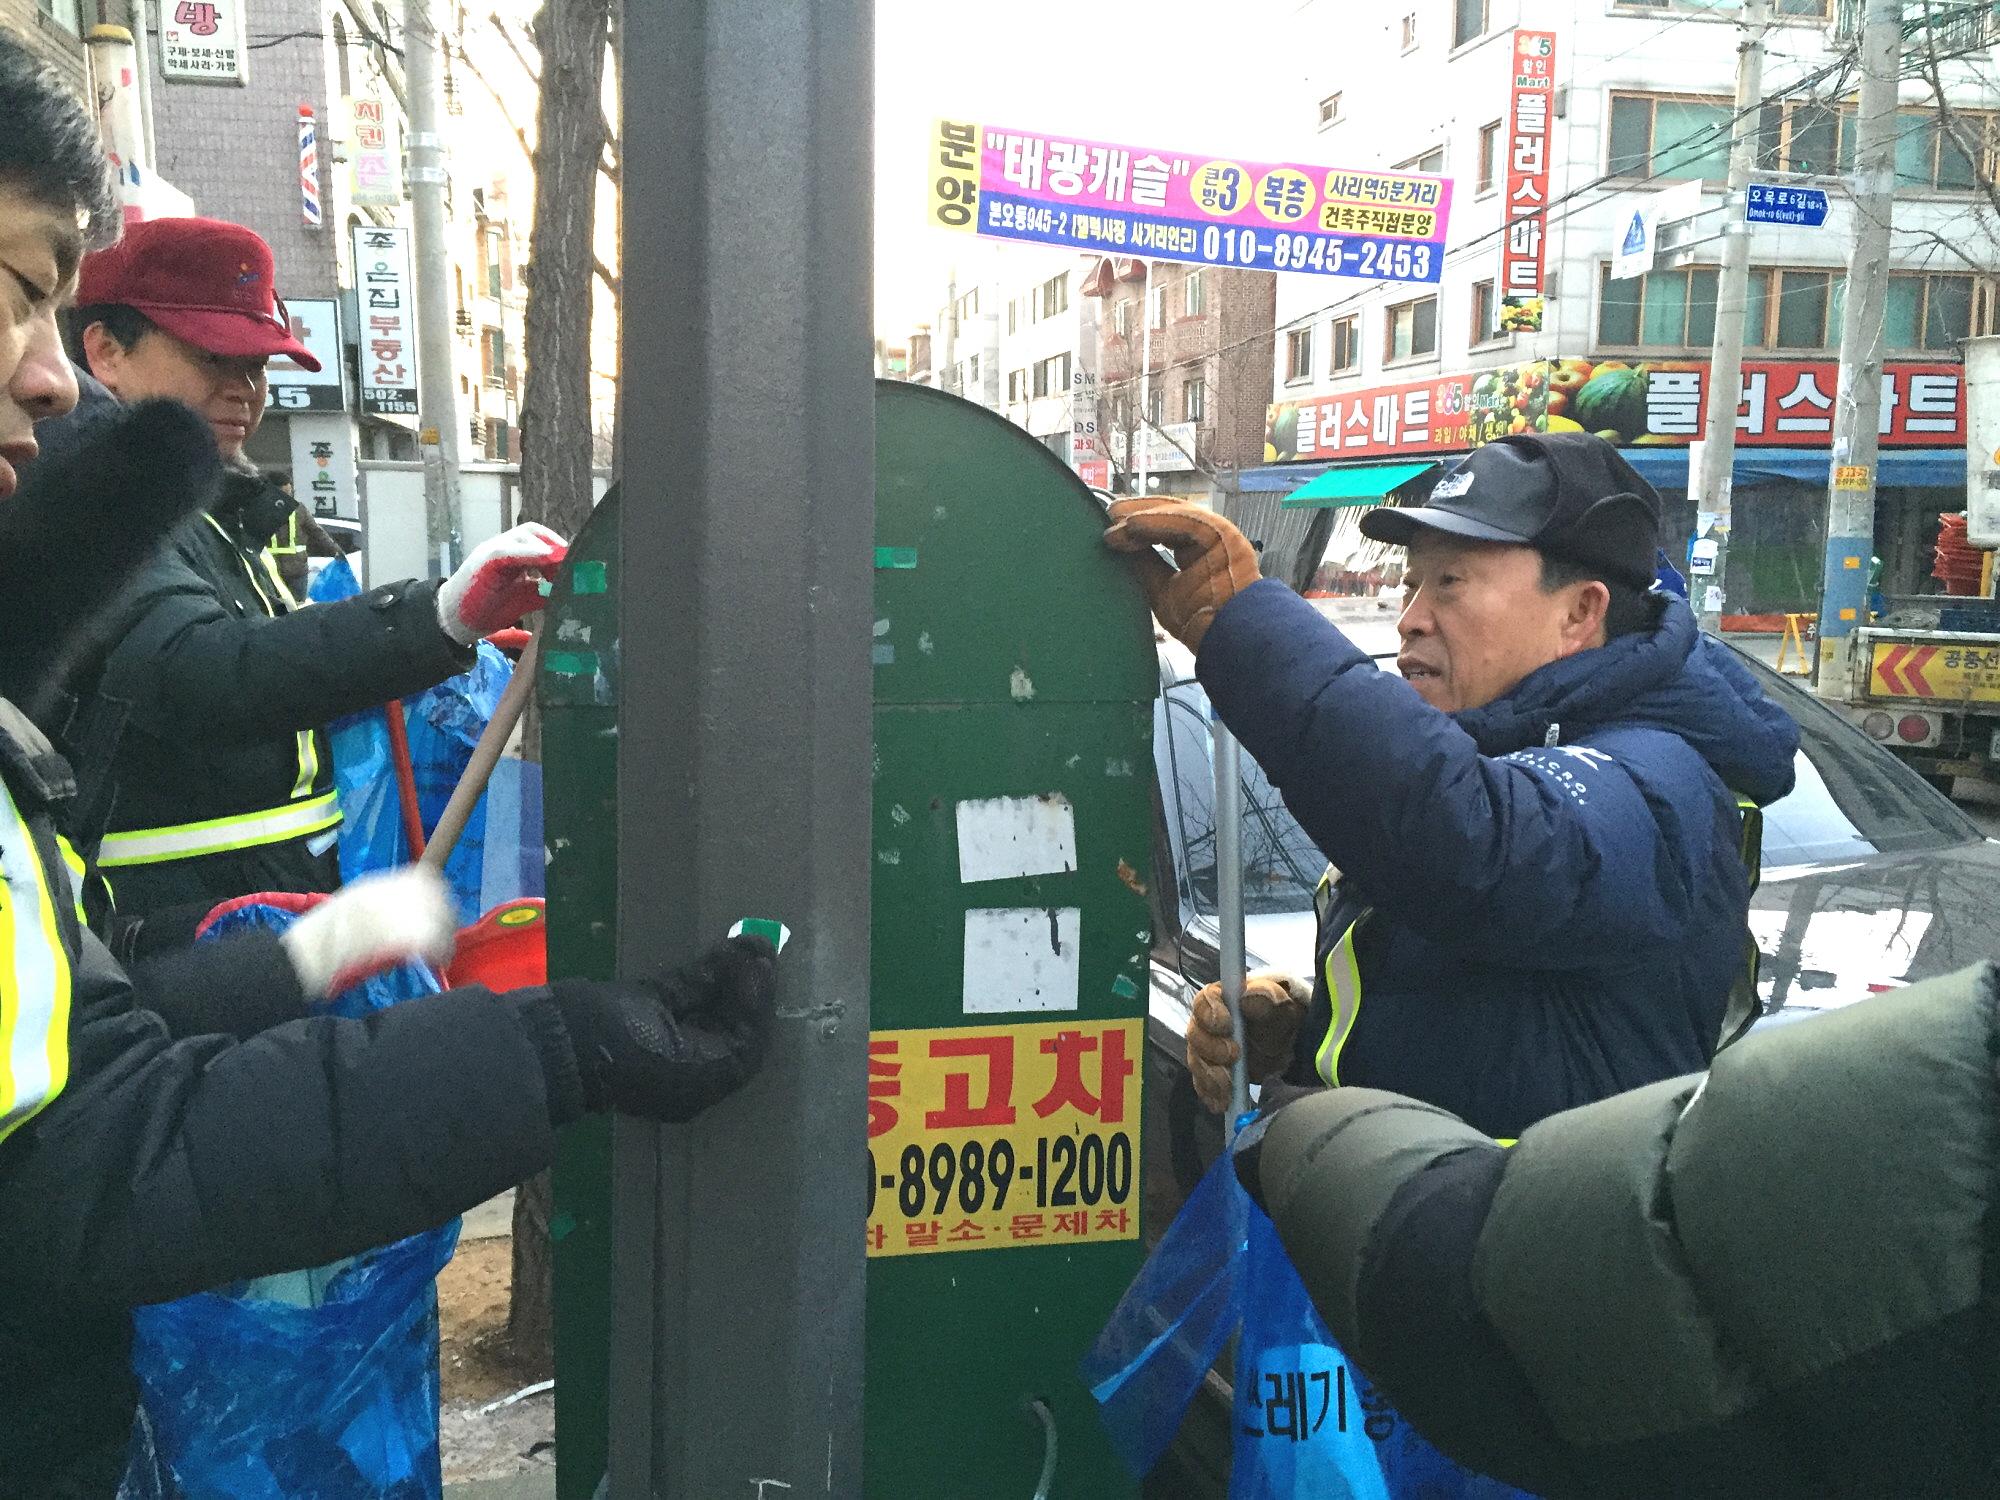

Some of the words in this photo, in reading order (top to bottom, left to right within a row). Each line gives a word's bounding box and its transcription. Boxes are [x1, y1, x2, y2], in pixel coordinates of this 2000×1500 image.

[174, 1, 222, 36] 방
[1516, 76, 1550, 87] Mart
[936, 120, 977, 226] 분양
[986, 132, 1190, 208] "태광캐슬"
[1263, 175, 1307, 219] 복층
[1330, 175, 1438, 206] 사리역5분거리
[1507, 93, 1547, 298] 플러스마트
[988, 200, 1067, 236] 본오동945-2
[1325, 206, 1432, 236] 건축주직접분양
[1203, 225, 1431, 280] 010-8945-2453
[364, 389, 403, 400] 502-
[377, 401, 417, 413] 1155
[1435, 382, 1463, 415] 365
[1074, 422, 1095, 433] DS
[1297, 389, 1430, 453] 플러스마트
[309, 441, 338, 515] 좋은집
